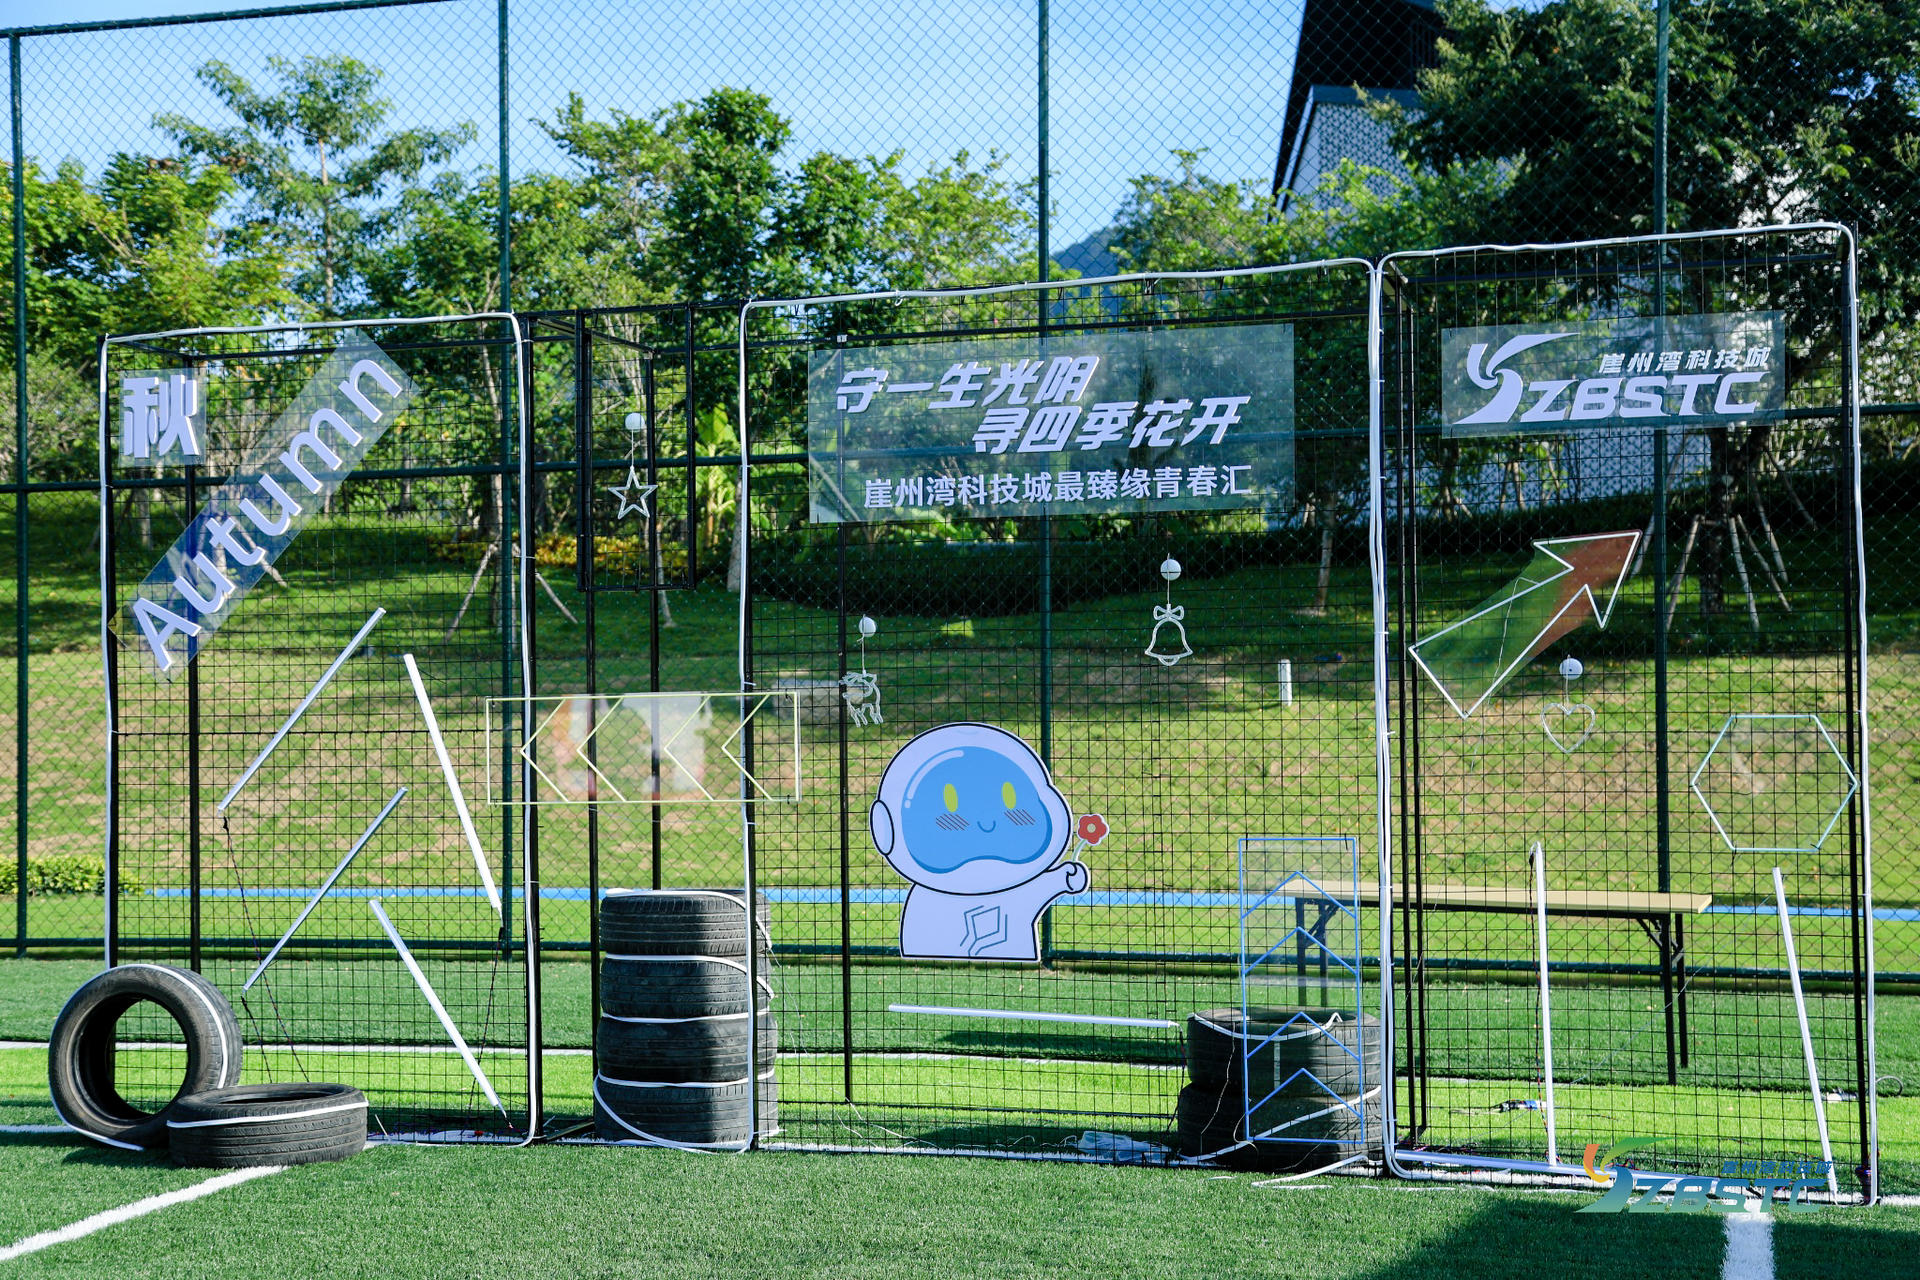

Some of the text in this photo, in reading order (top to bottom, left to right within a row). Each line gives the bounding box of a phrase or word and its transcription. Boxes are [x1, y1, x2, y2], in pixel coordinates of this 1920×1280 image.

[835, 355, 1100, 413] 守一生光阴
[1598, 347, 1772, 374] 崖州湾科技城
[122, 374, 200, 458] 秋
[971, 395, 1252, 455] 寻四季花开
[131, 358, 403, 673] Autumn
[863, 463, 1254, 509] 崖州湾科技城最臻缘青春汇
